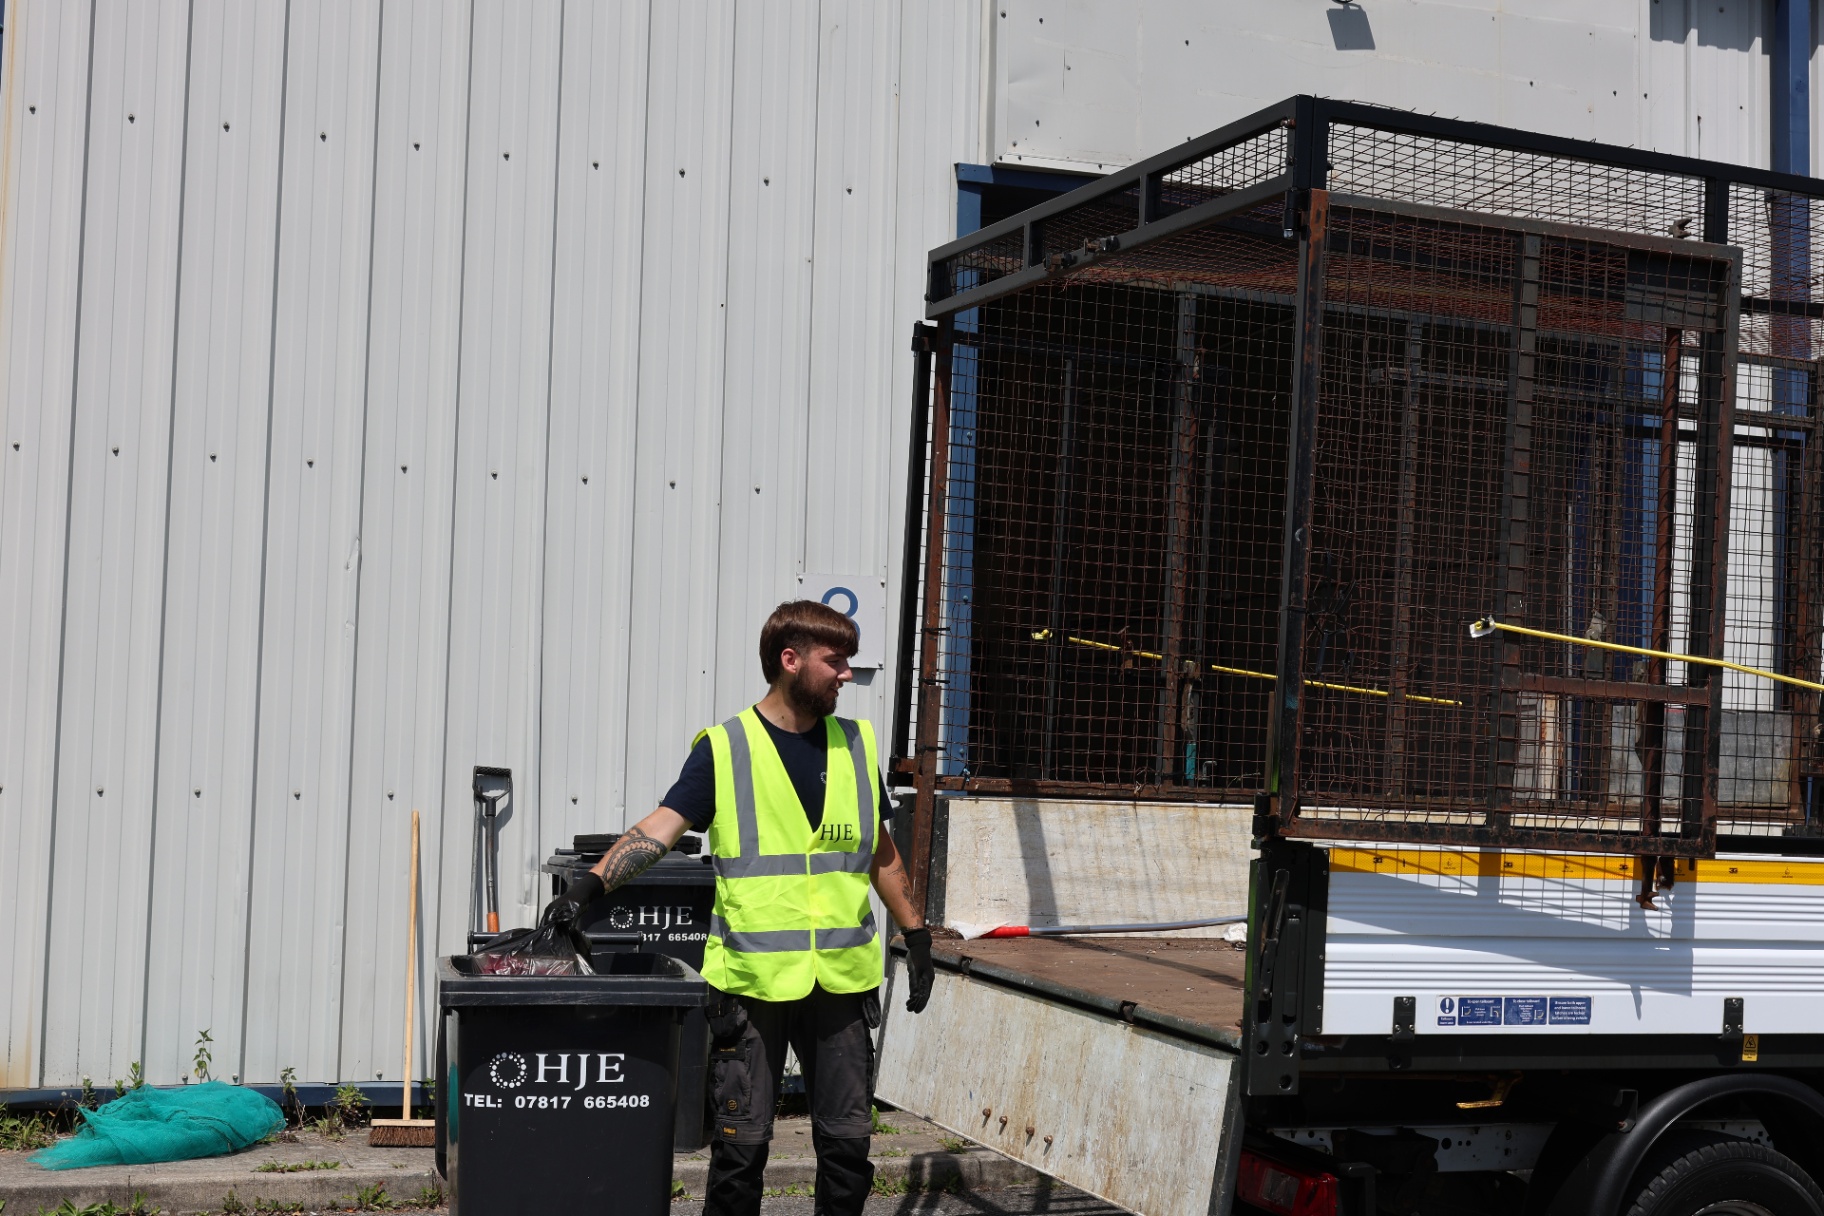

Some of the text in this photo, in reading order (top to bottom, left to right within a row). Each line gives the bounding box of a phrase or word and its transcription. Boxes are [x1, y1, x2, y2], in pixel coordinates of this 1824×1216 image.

[820, 823, 854, 843] HJE
[638, 906, 693, 930] HJE
[668, 932, 708, 942] 665408
[534, 1053, 625, 1091] HJE
[464, 1093, 650, 1109] TEL: 07817 665408
